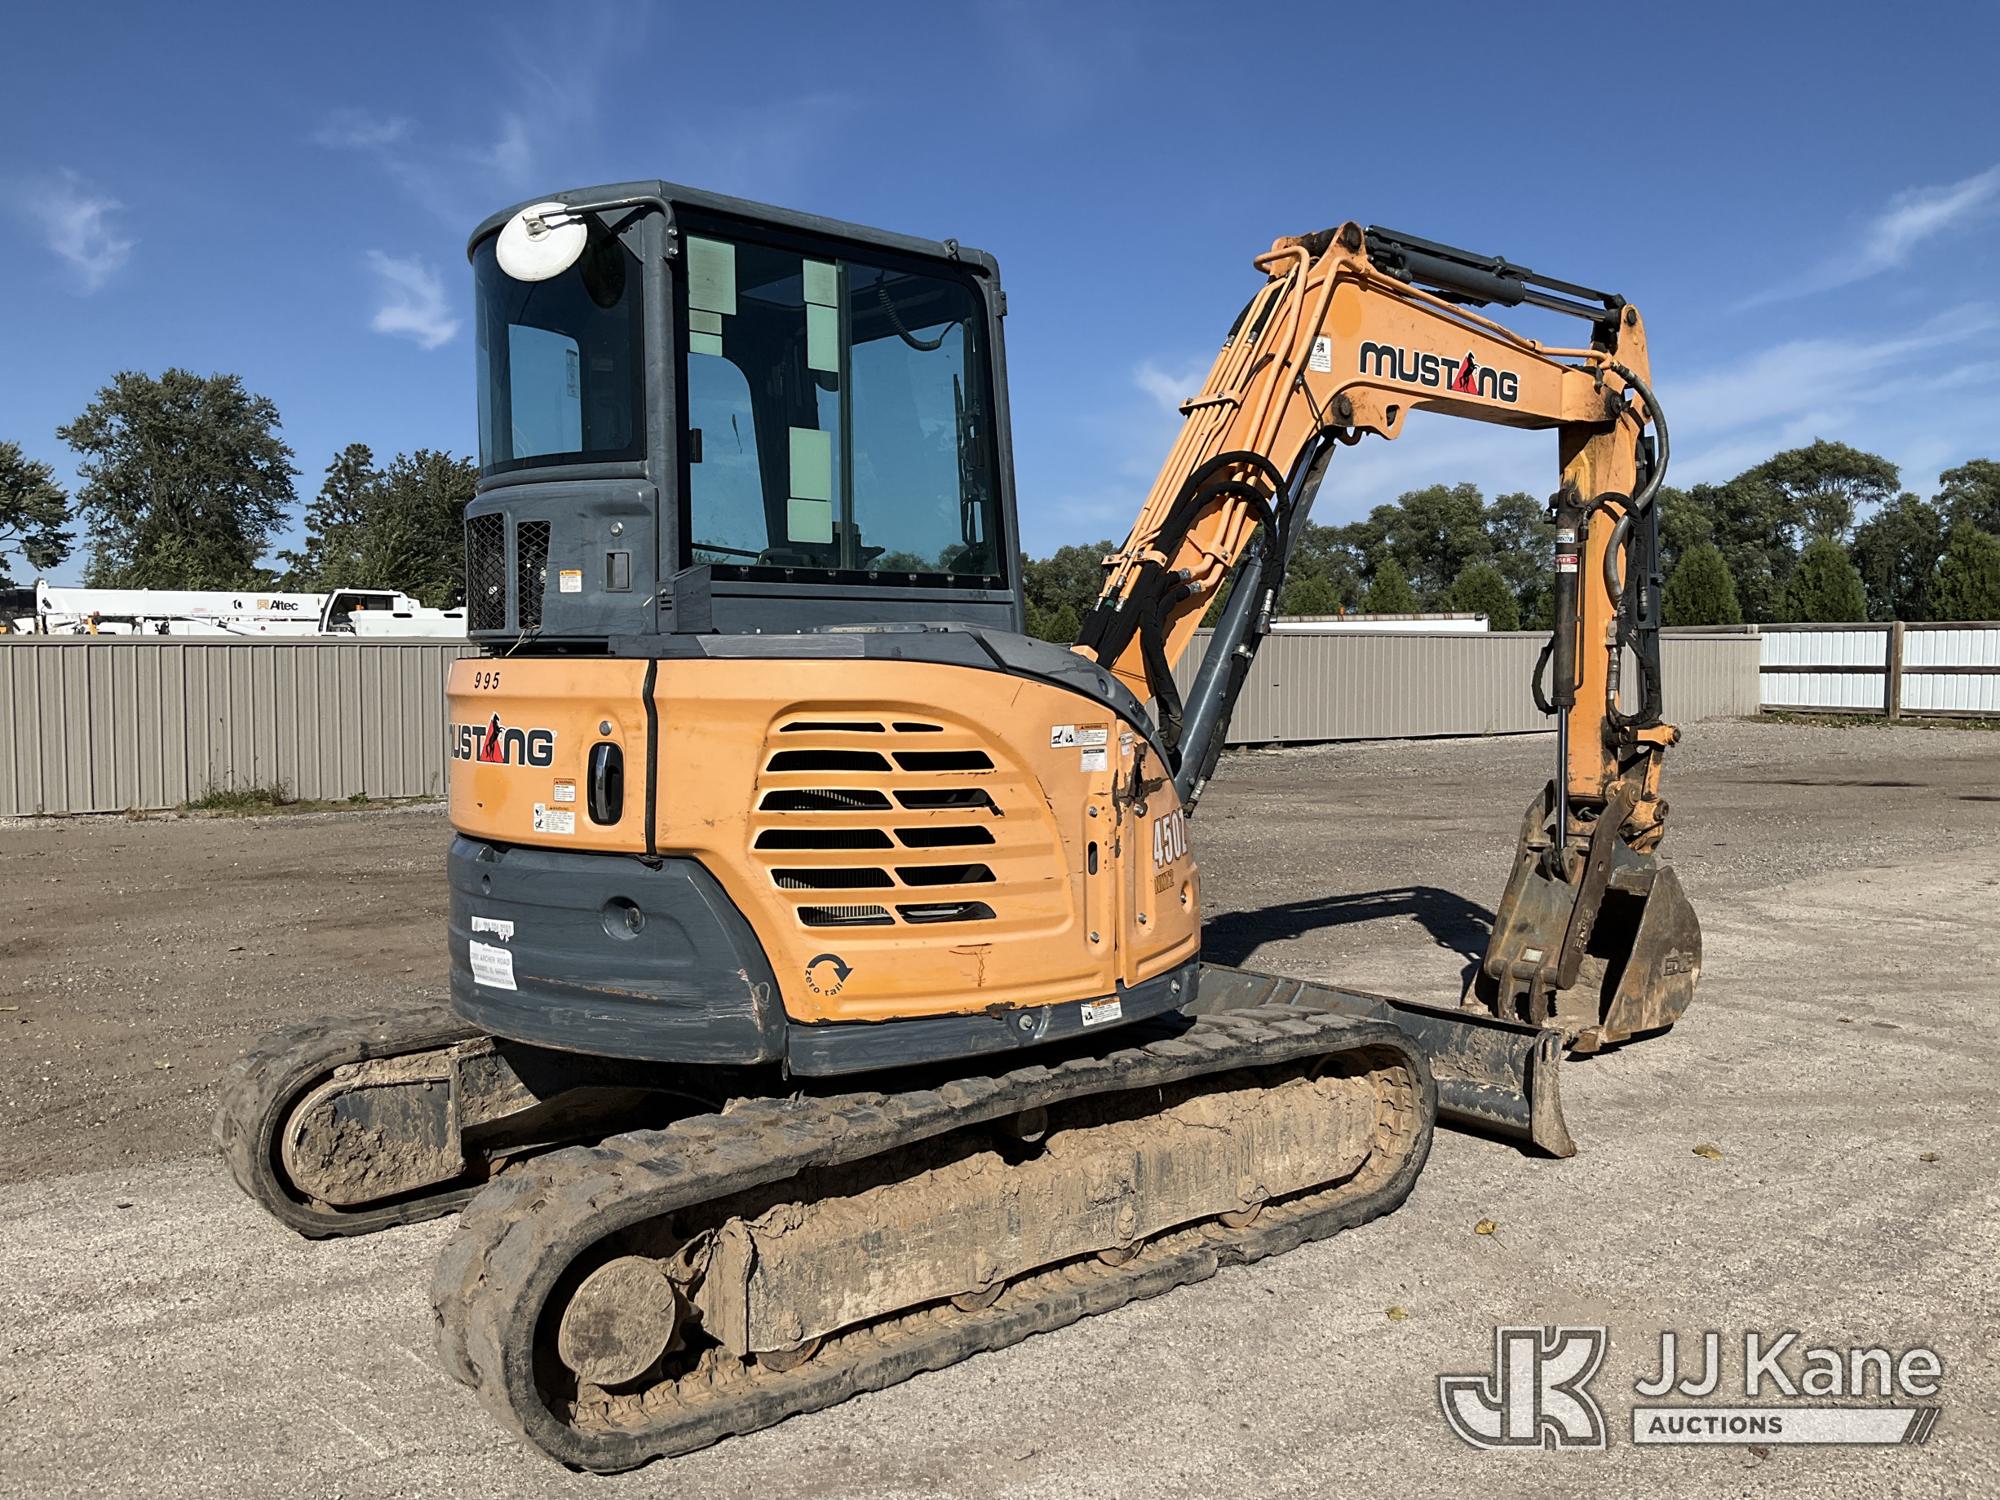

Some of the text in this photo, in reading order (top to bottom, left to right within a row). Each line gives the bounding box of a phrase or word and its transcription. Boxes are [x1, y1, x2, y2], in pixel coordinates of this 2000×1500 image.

[1359, 341, 1518, 403] MUSTANG
[270, 599, 299, 611] Altec
[474, 671, 501, 690] 995
[449, 713, 554, 767] USTANG
[804, 969, 843, 996] zero tail
